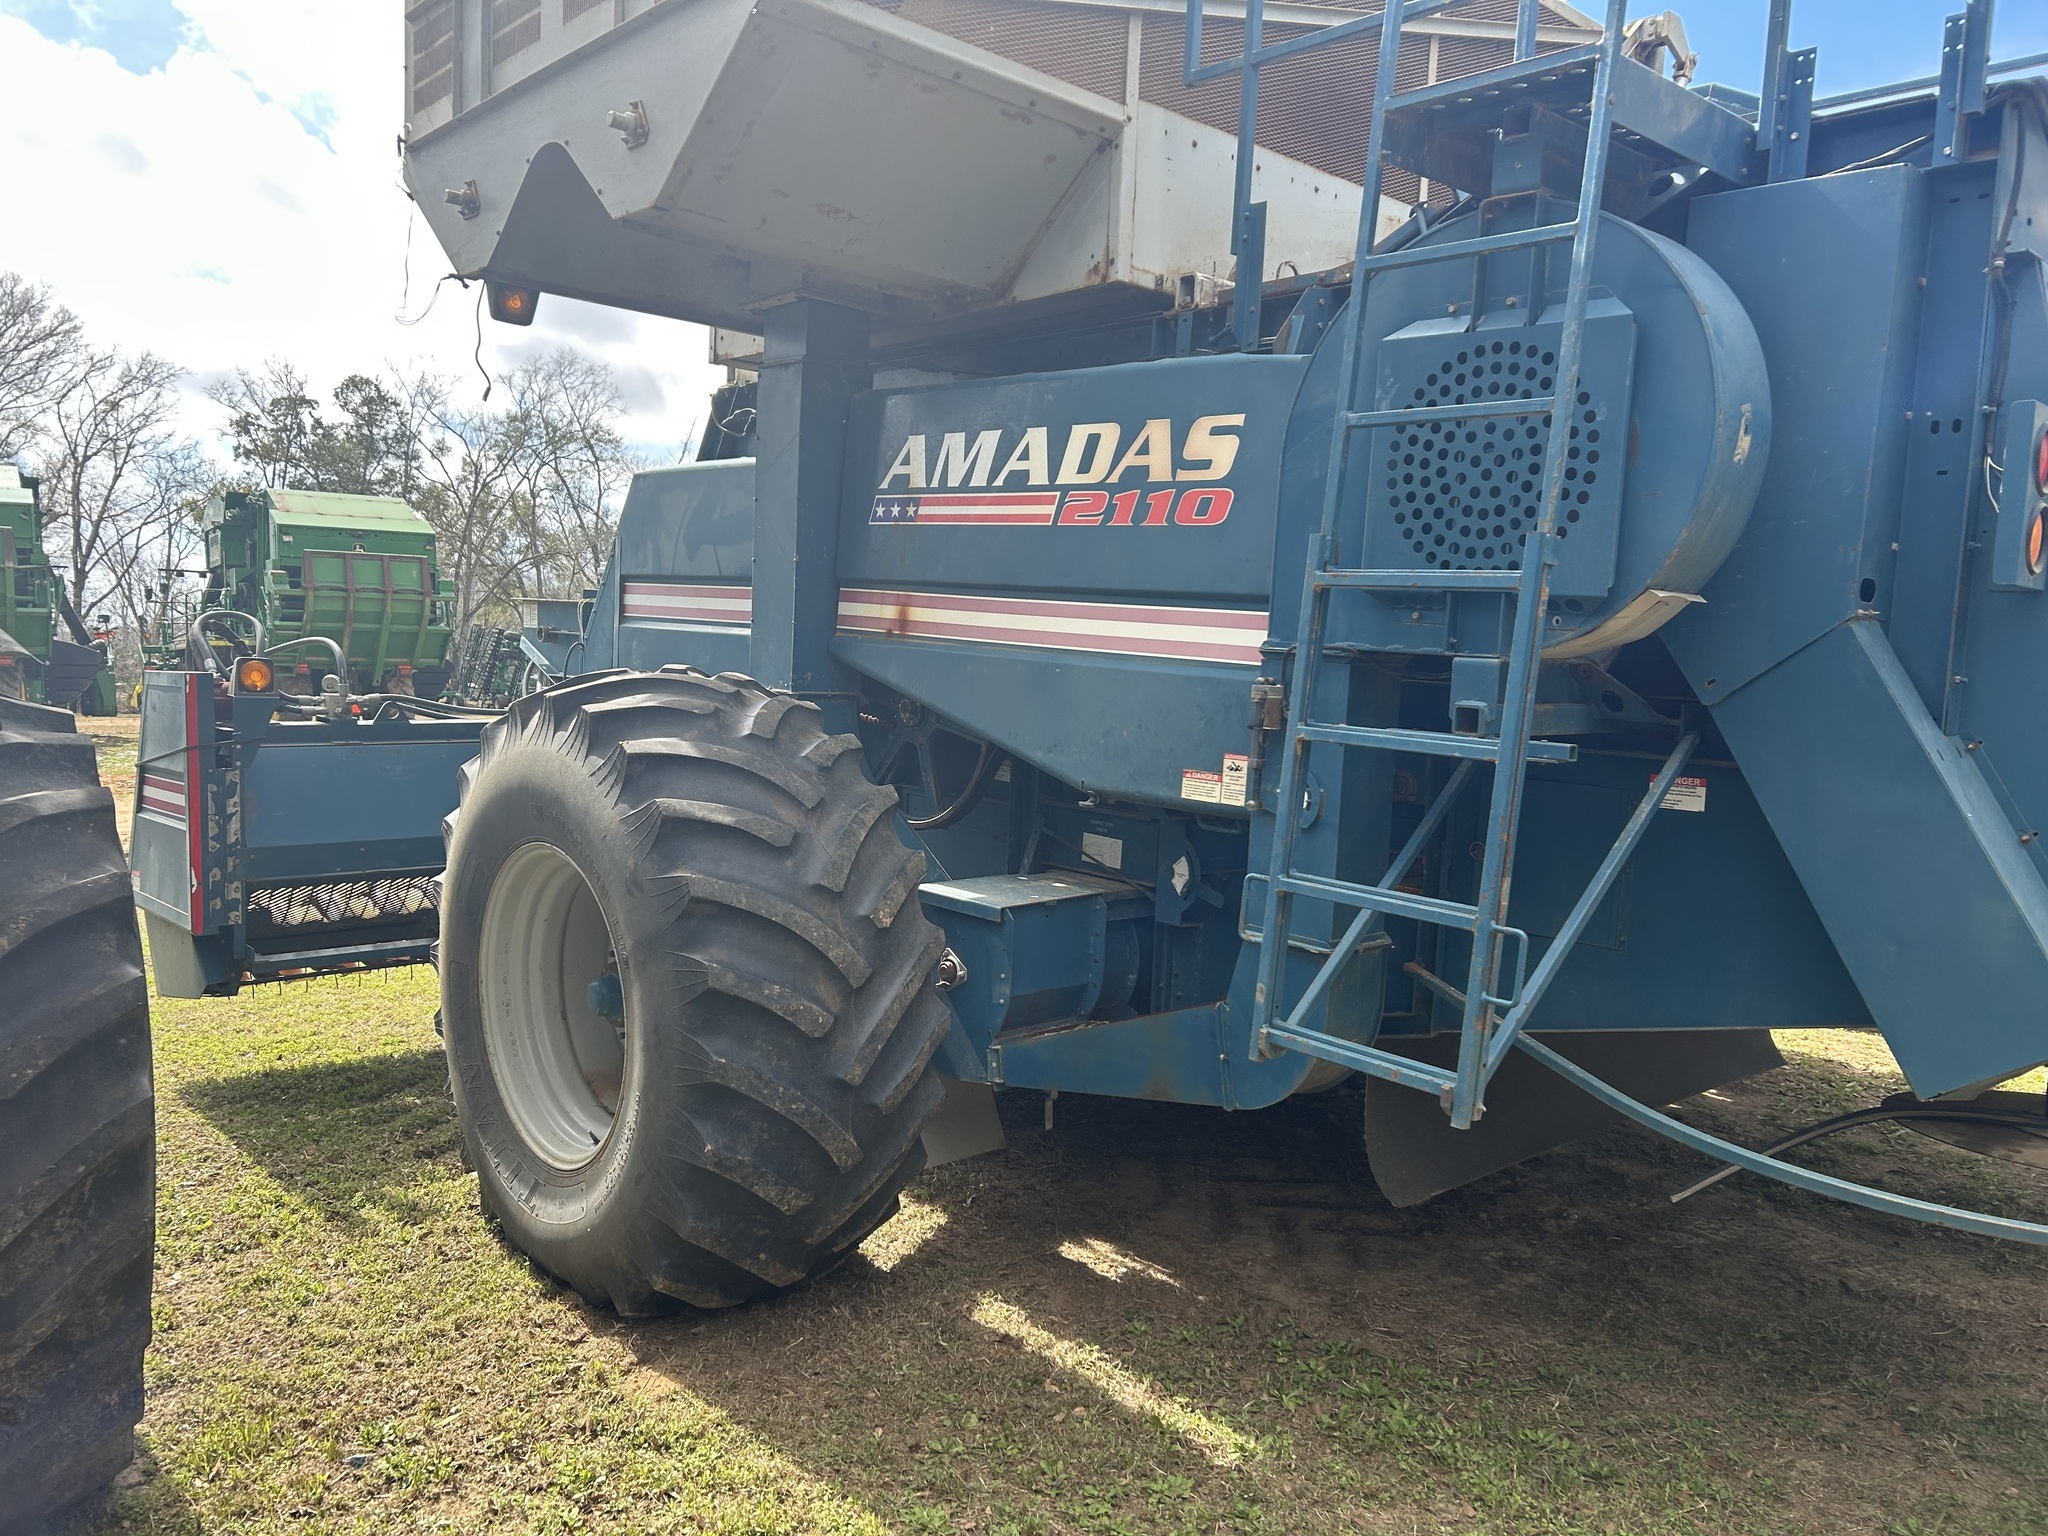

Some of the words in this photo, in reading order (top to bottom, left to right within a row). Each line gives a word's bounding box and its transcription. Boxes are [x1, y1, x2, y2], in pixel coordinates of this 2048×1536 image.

[878, 413, 1246, 489] AMADAS
[1057, 487, 1235, 526] 2110
[1192, 772, 1219, 781] DANGER
[460, 1063, 545, 1215] TITAN
